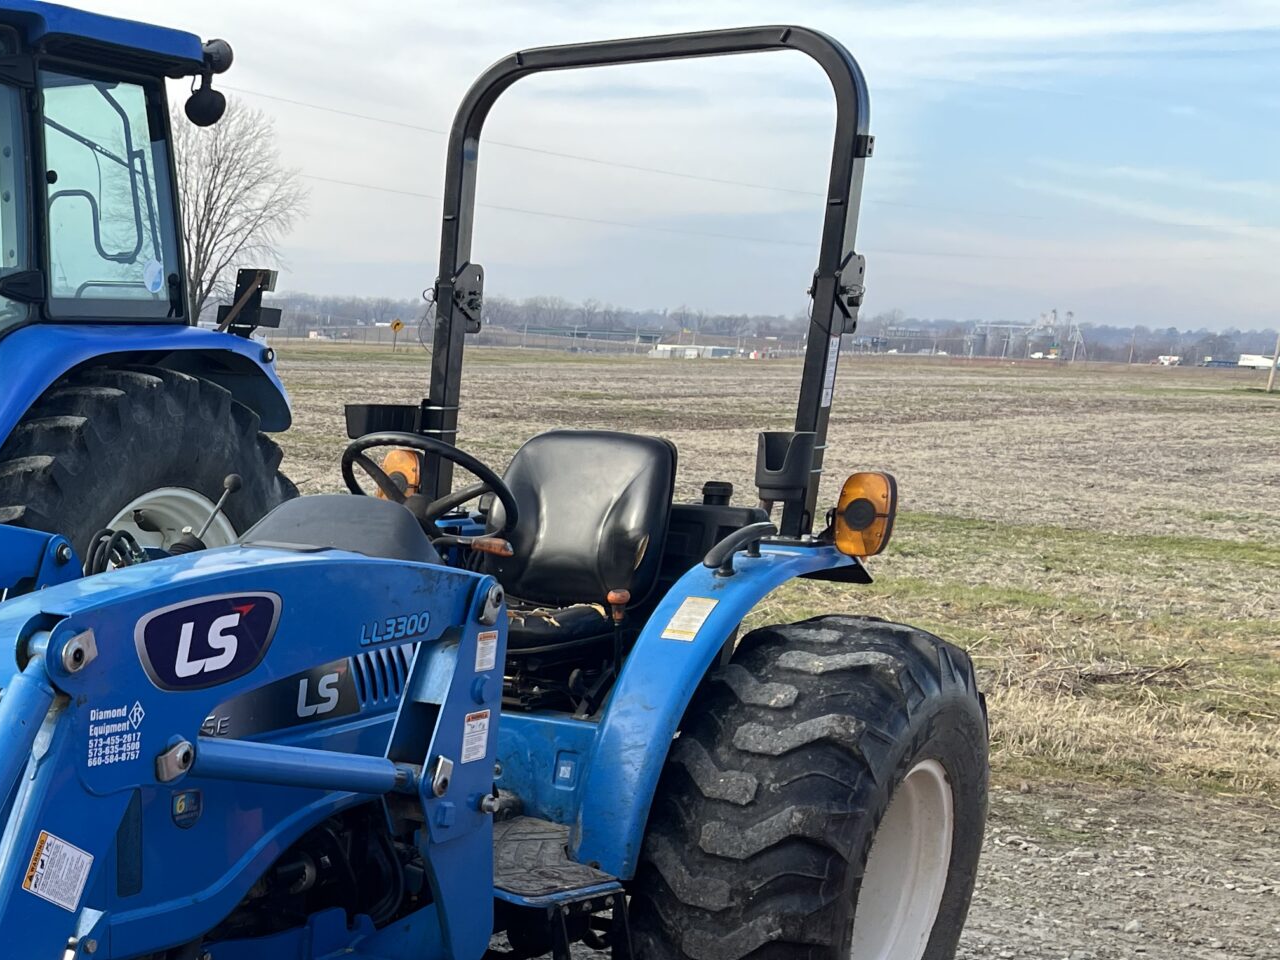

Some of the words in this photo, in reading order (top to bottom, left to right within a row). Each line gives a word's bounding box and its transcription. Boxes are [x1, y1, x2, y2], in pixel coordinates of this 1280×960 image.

[360, 611, 430, 645] LL3300
[174, 613, 241, 678] LS
[296, 672, 339, 718] LS
[89, 720, 130, 737] Equipment
[90, 705, 127, 721] Diamond
[31, 839, 46, 873] WARNING
